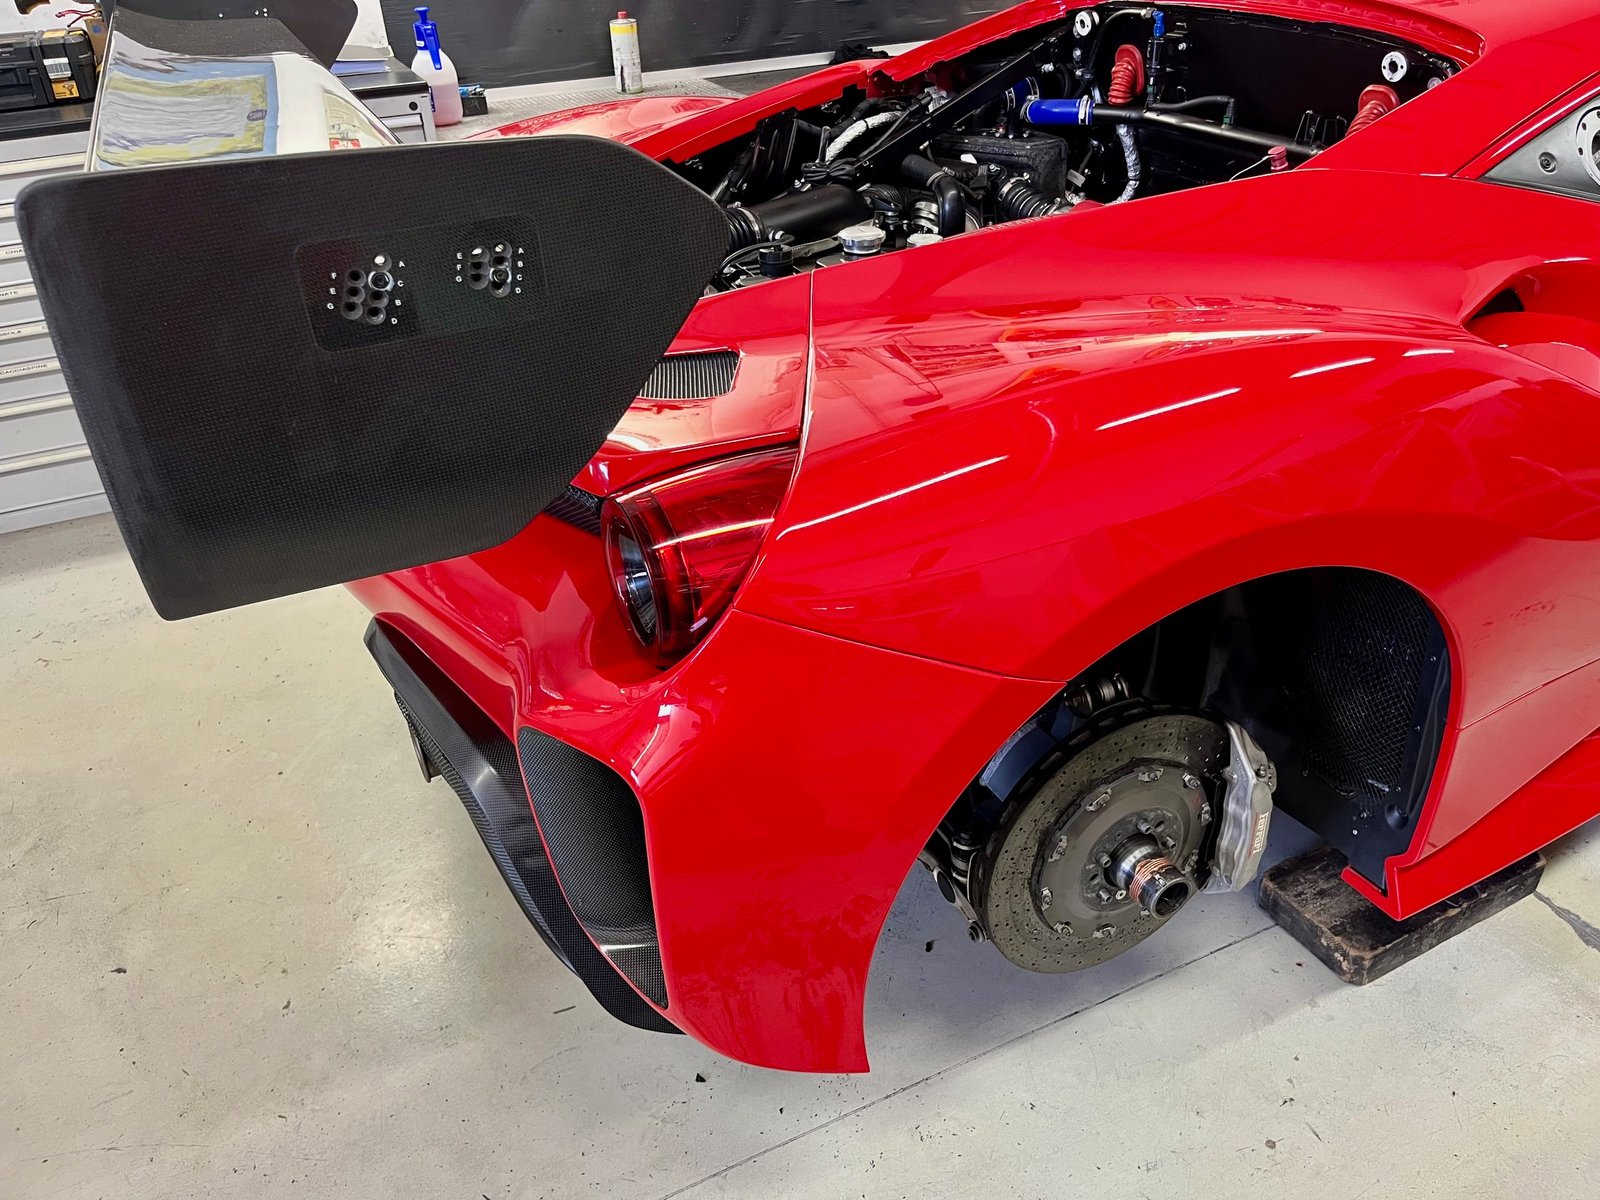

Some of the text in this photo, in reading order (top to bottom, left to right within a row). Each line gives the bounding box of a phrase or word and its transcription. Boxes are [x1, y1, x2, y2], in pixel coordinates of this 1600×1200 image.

[518, 247, 525, 255] A
[456, 252, 463, 260] E
[398, 260, 406, 268] A
[456, 263, 462, 271] F
[517, 260, 524, 268] B
[331, 272, 337, 280] F
[455, 275, 463, 283] G
[516, 273, 523, 281] C
[397, 279, 404, 287] C
[329, 287, 337, 295] E
[326, 302, 335, 310] G
[394, 299, 402, 307] B
[390, 317, 398, 325] D
[1252, 811, 1269, 854] Ferrari
